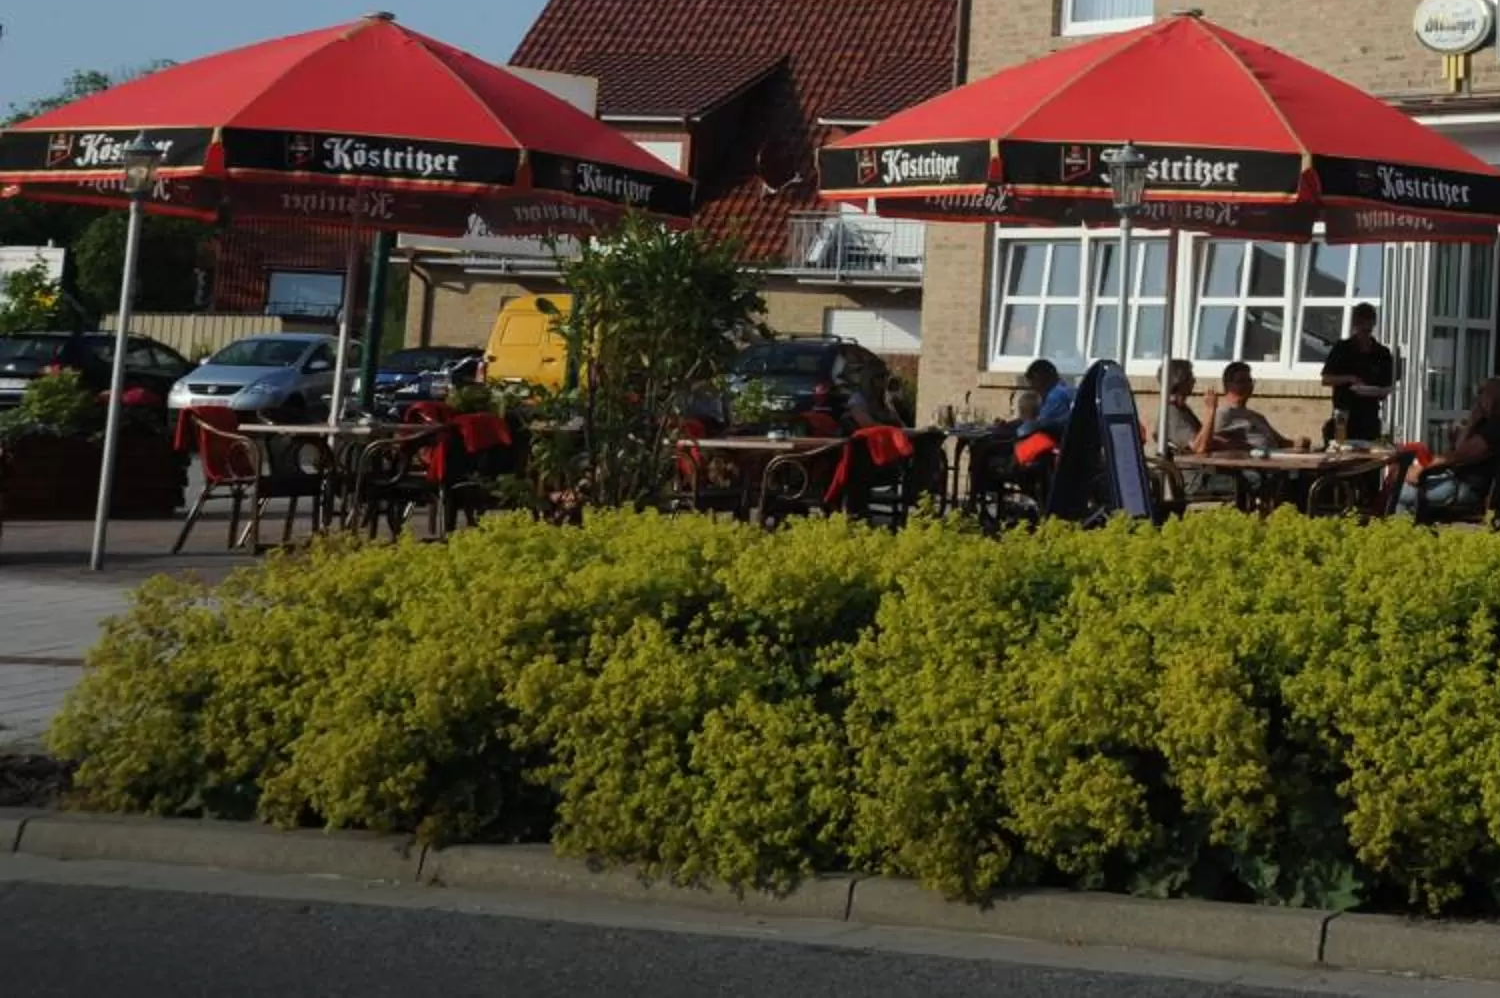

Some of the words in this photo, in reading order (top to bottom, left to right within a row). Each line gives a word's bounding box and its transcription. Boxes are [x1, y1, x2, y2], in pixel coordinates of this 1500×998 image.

[323, 137, 459, 177] Köstritzer
[881, 149, 961, 184] Köstritzer
[1377, 165, 1472, 205] Köstritzer
